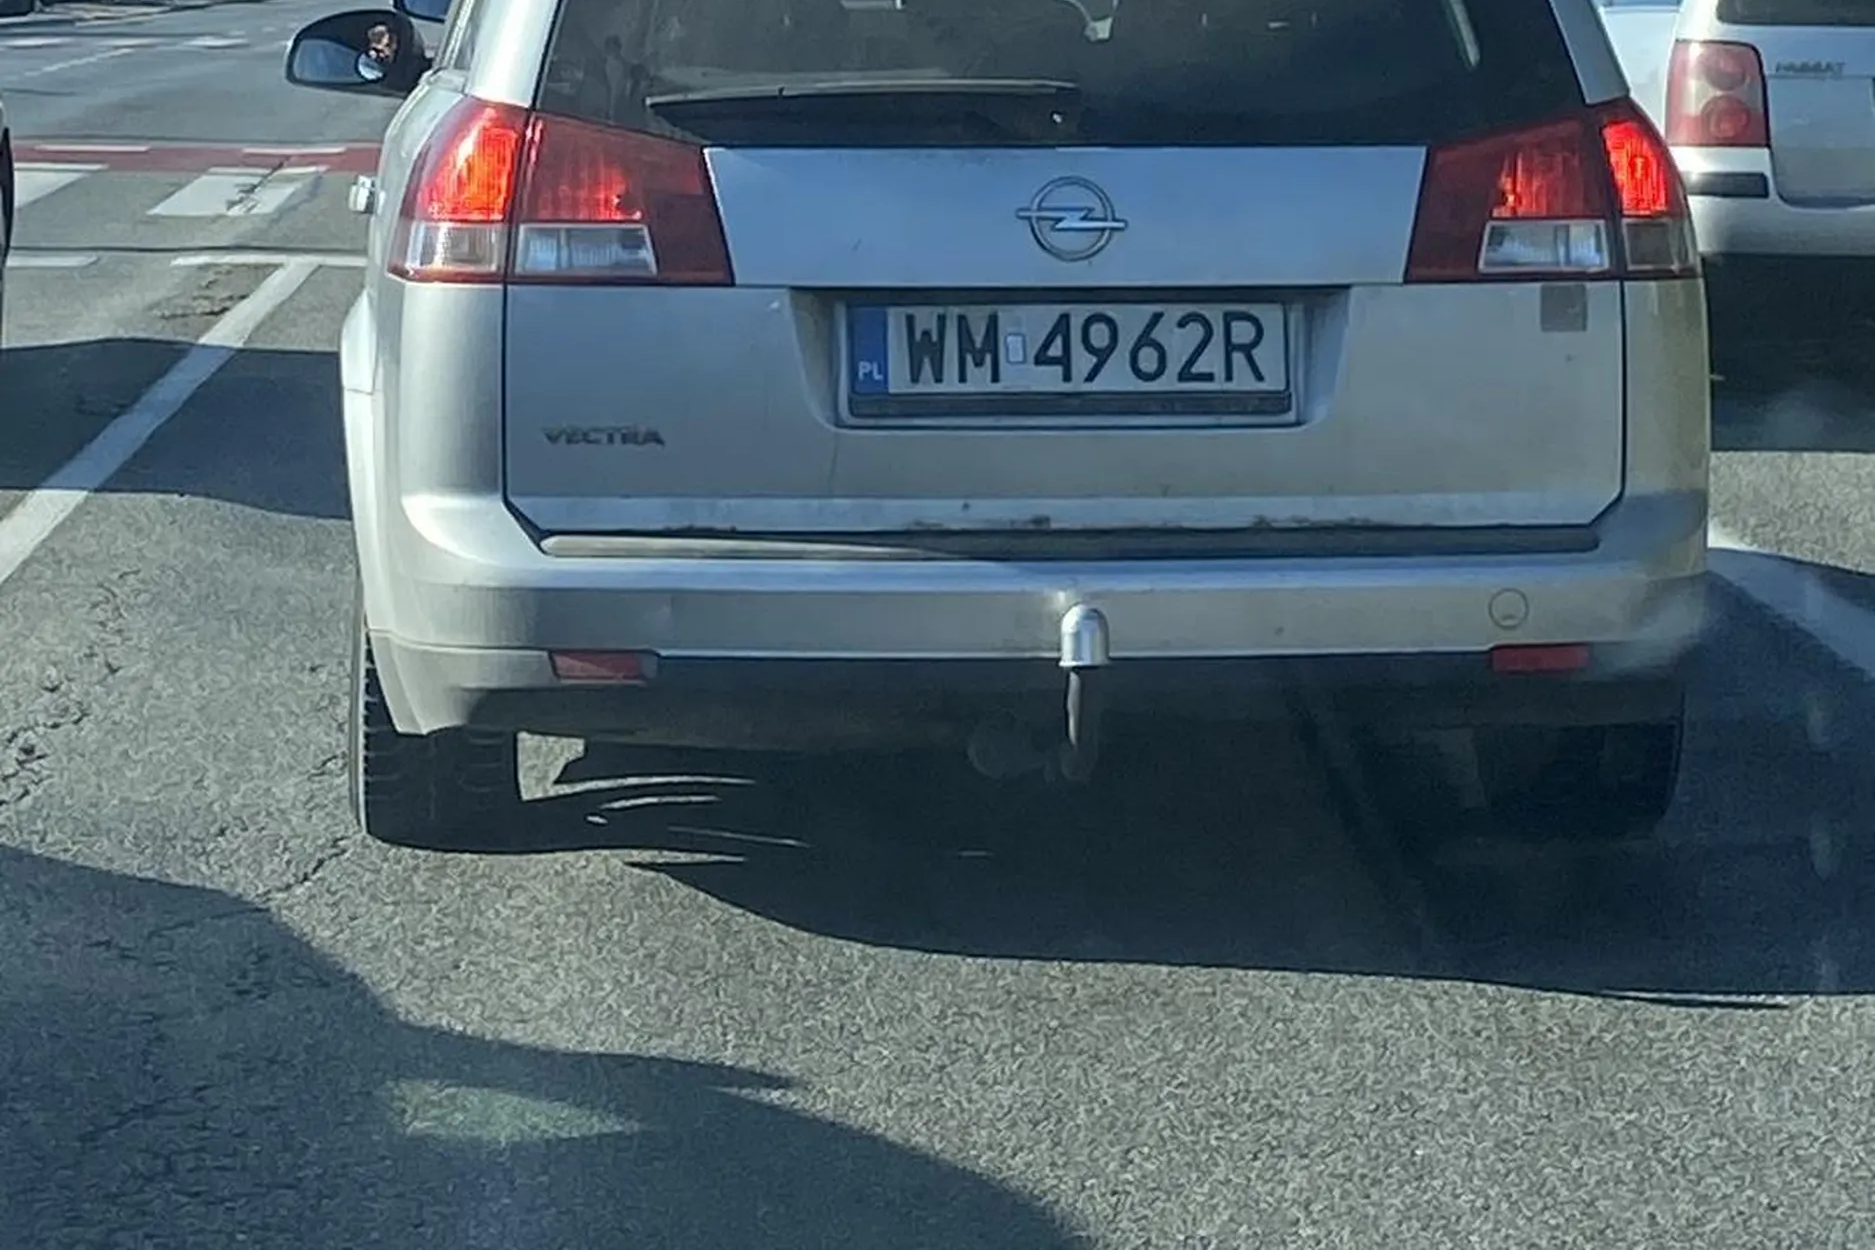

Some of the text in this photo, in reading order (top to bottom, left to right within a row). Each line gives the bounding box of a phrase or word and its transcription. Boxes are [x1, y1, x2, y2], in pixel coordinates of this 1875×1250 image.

[905, 311, 1266, 384] WM 4962R
[857, 361, 884, 380] PL
[543, 426, 665, 447] VECTRA
